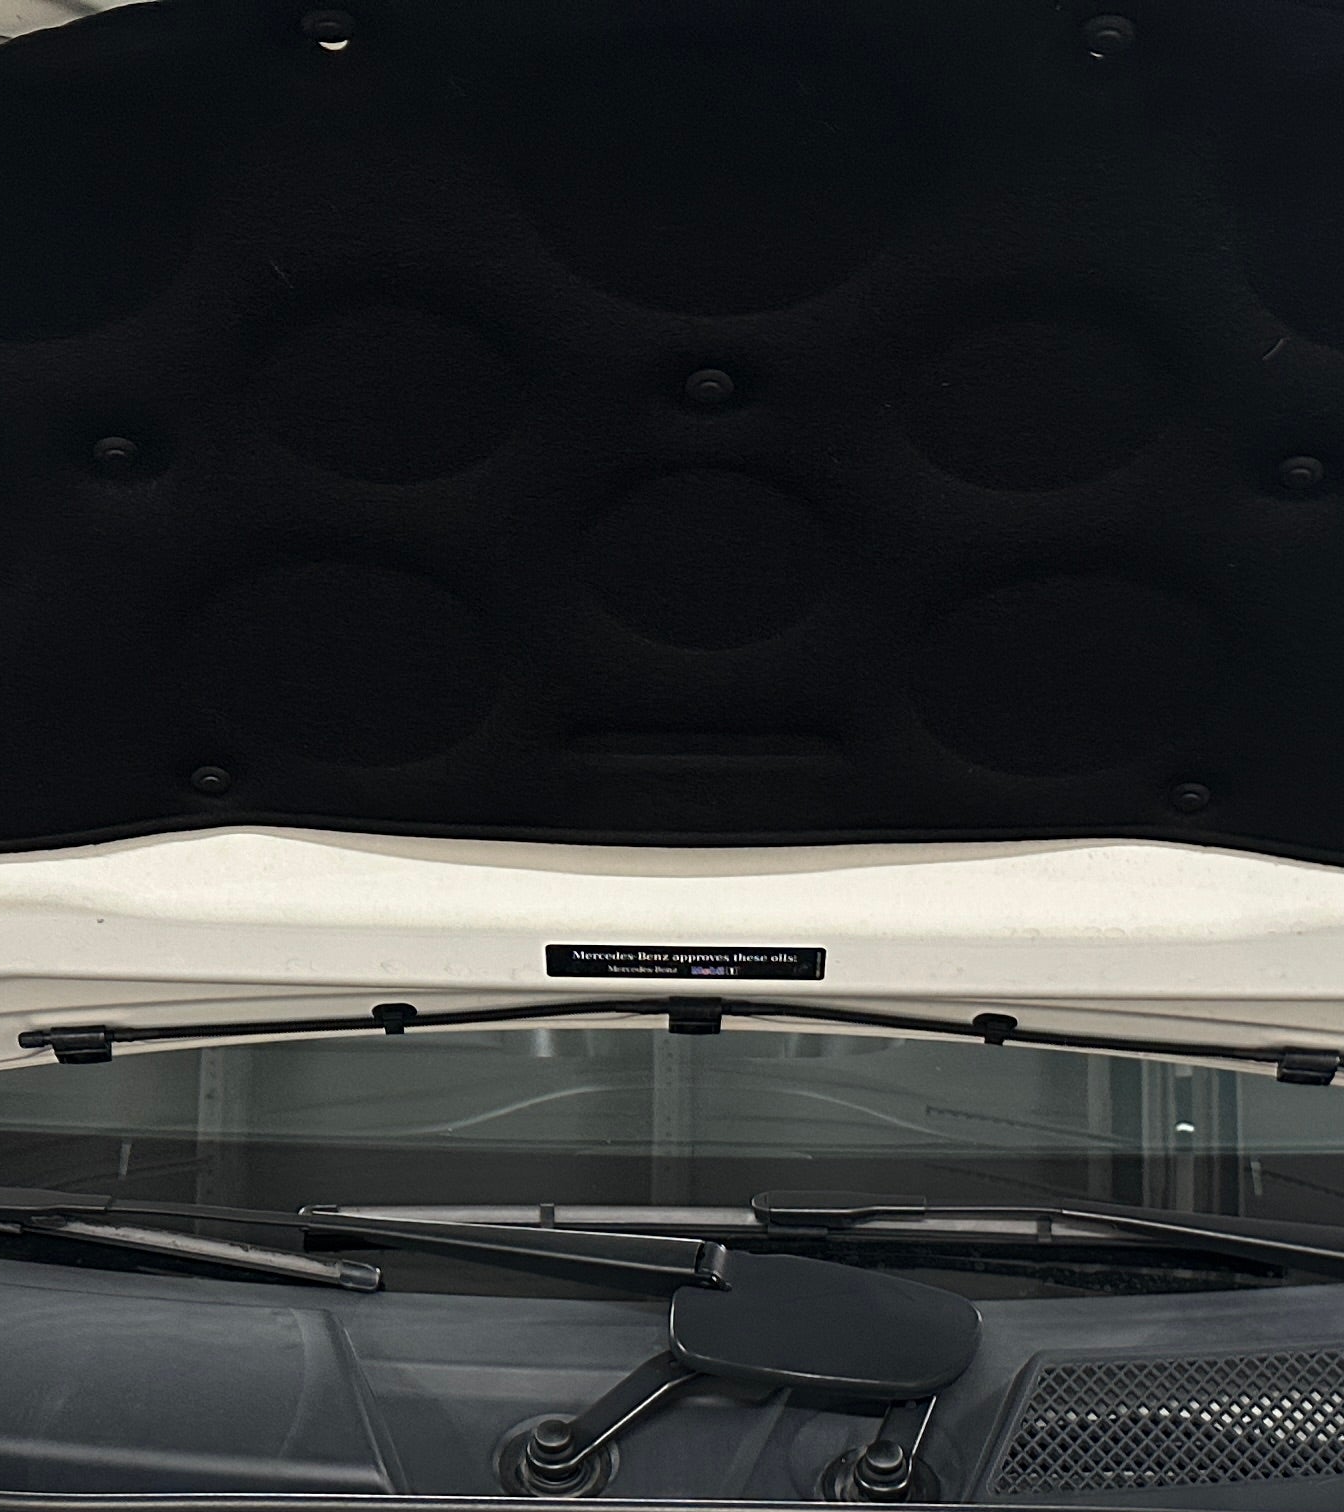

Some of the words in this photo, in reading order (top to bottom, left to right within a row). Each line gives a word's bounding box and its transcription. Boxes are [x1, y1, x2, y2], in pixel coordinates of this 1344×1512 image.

[572, 950, 669, 962] Mercedes-Benz
[672, 953, 729, 964] approves
[733, 953, 767, 963] these
